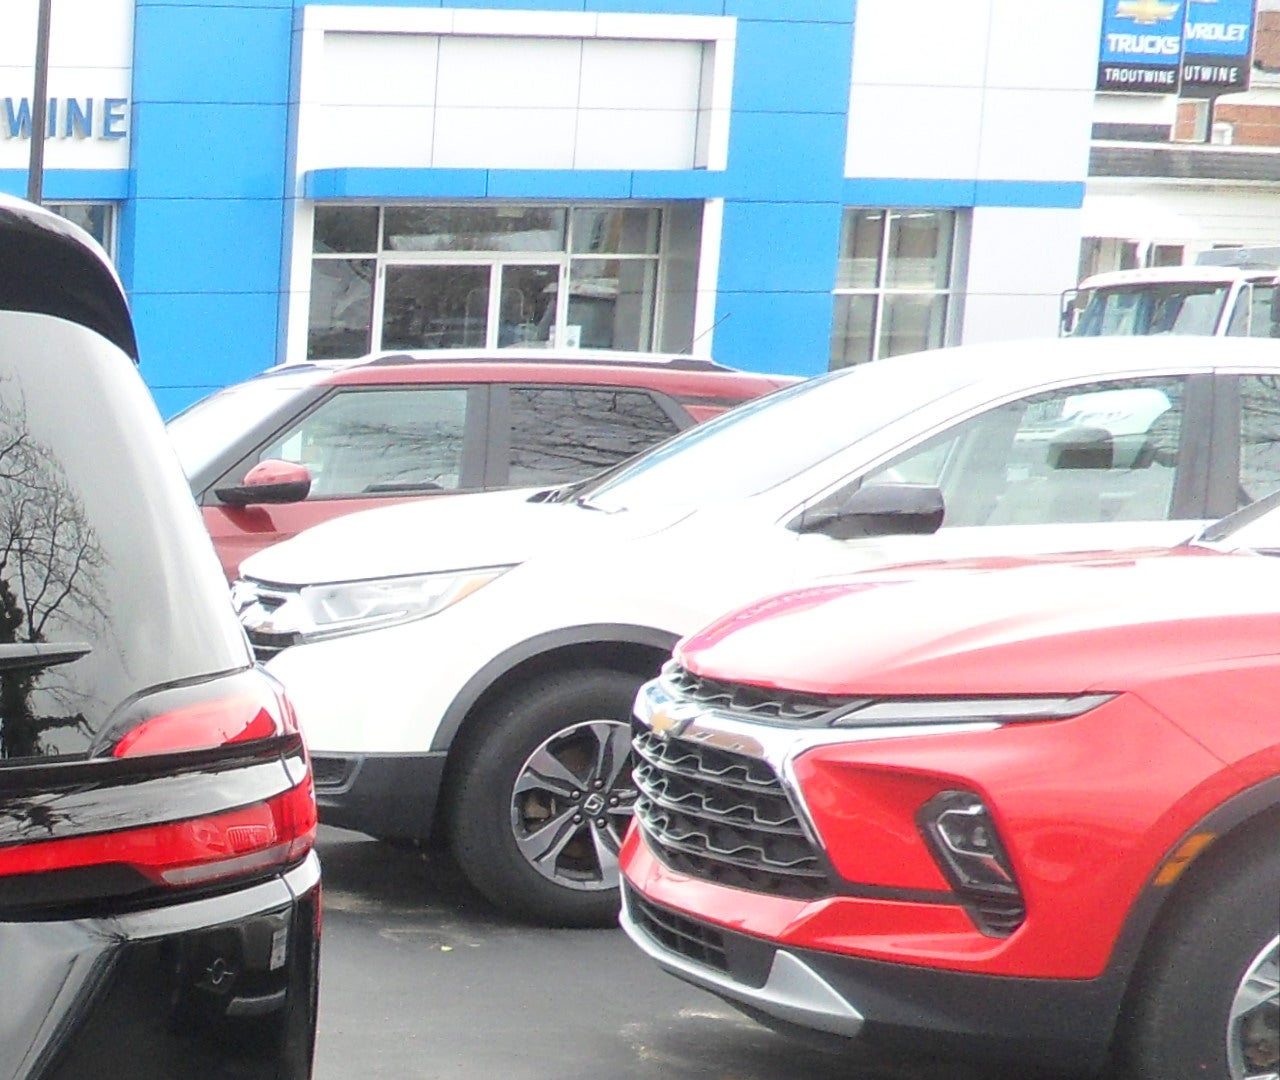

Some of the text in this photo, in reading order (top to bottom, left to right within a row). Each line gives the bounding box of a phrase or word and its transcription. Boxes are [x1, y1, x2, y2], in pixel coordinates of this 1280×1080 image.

[1184, 23, 1249, 41] VROLET
[1107, 34, 1181, 54] TRUCKS
[1105, 68, 1175, 84] TROUTWINE
[1184, 65, 1238, 83] UTWINE
